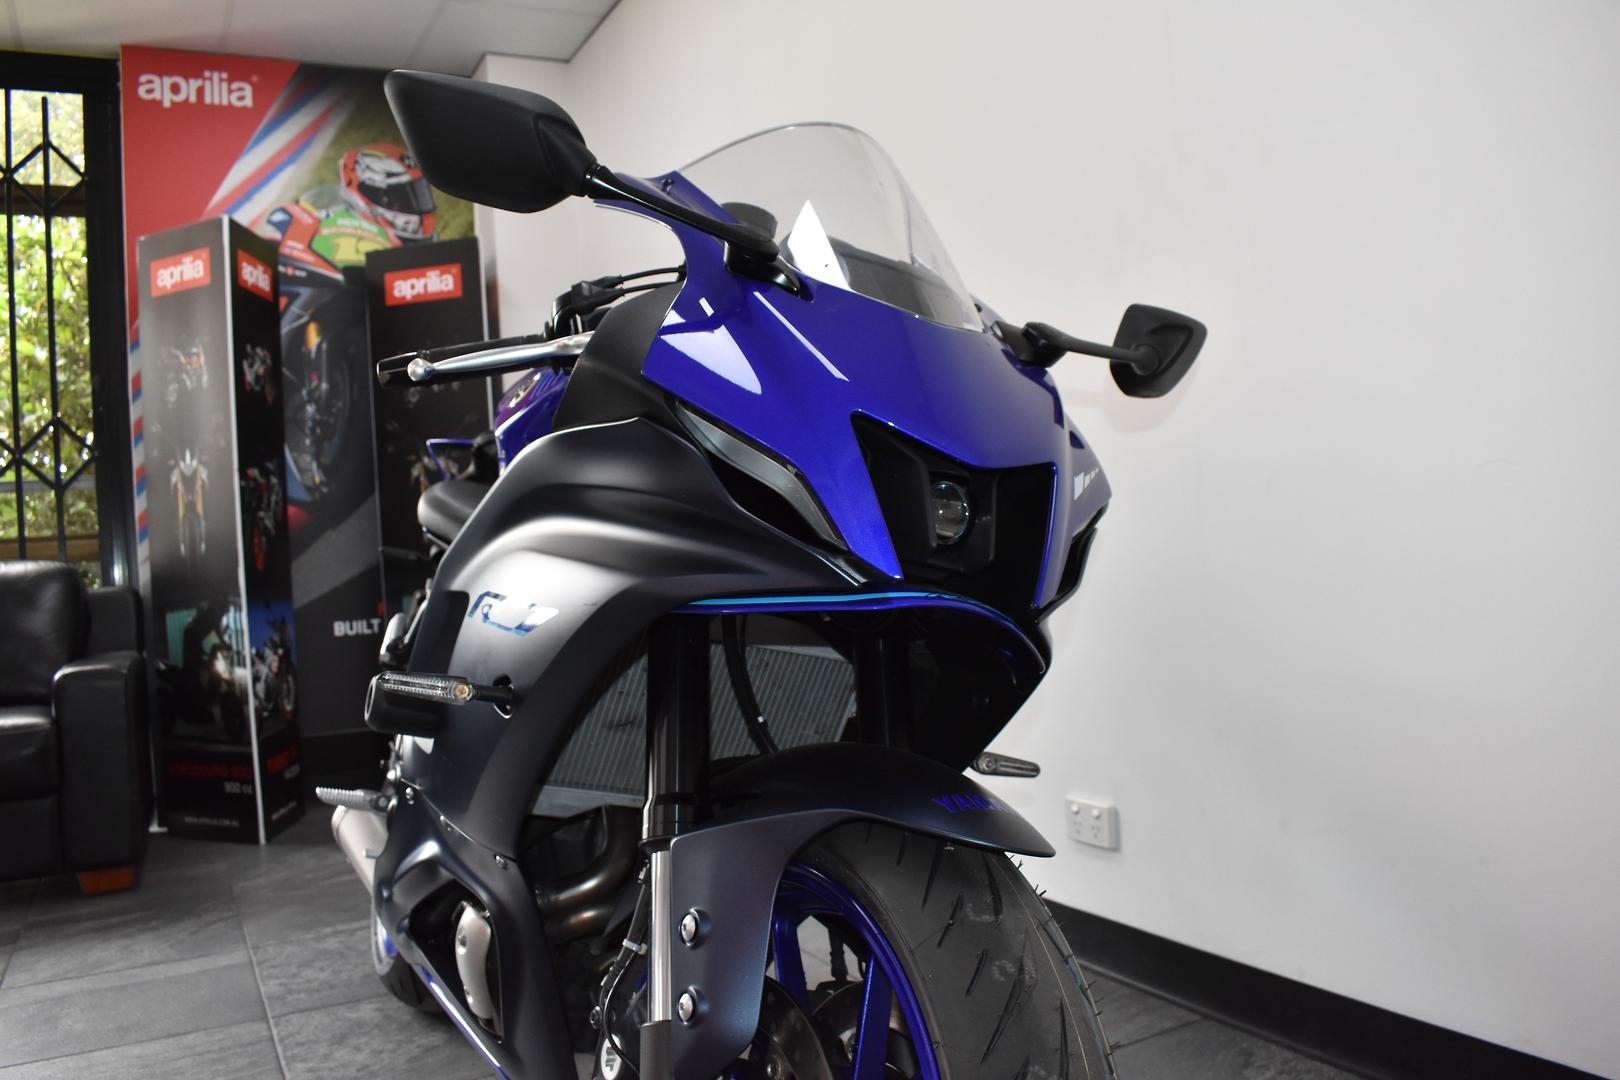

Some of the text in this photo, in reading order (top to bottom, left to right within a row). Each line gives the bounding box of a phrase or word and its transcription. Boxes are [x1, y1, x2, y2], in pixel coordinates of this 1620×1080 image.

[137, 70, 253, 108] aprilia
[156, 255, 204, 290] aprilia
[240, 261, 271, 292] aprilia
[393, 270, 454, 300] aprilia
[333, 618, 381, 637] BUILT
